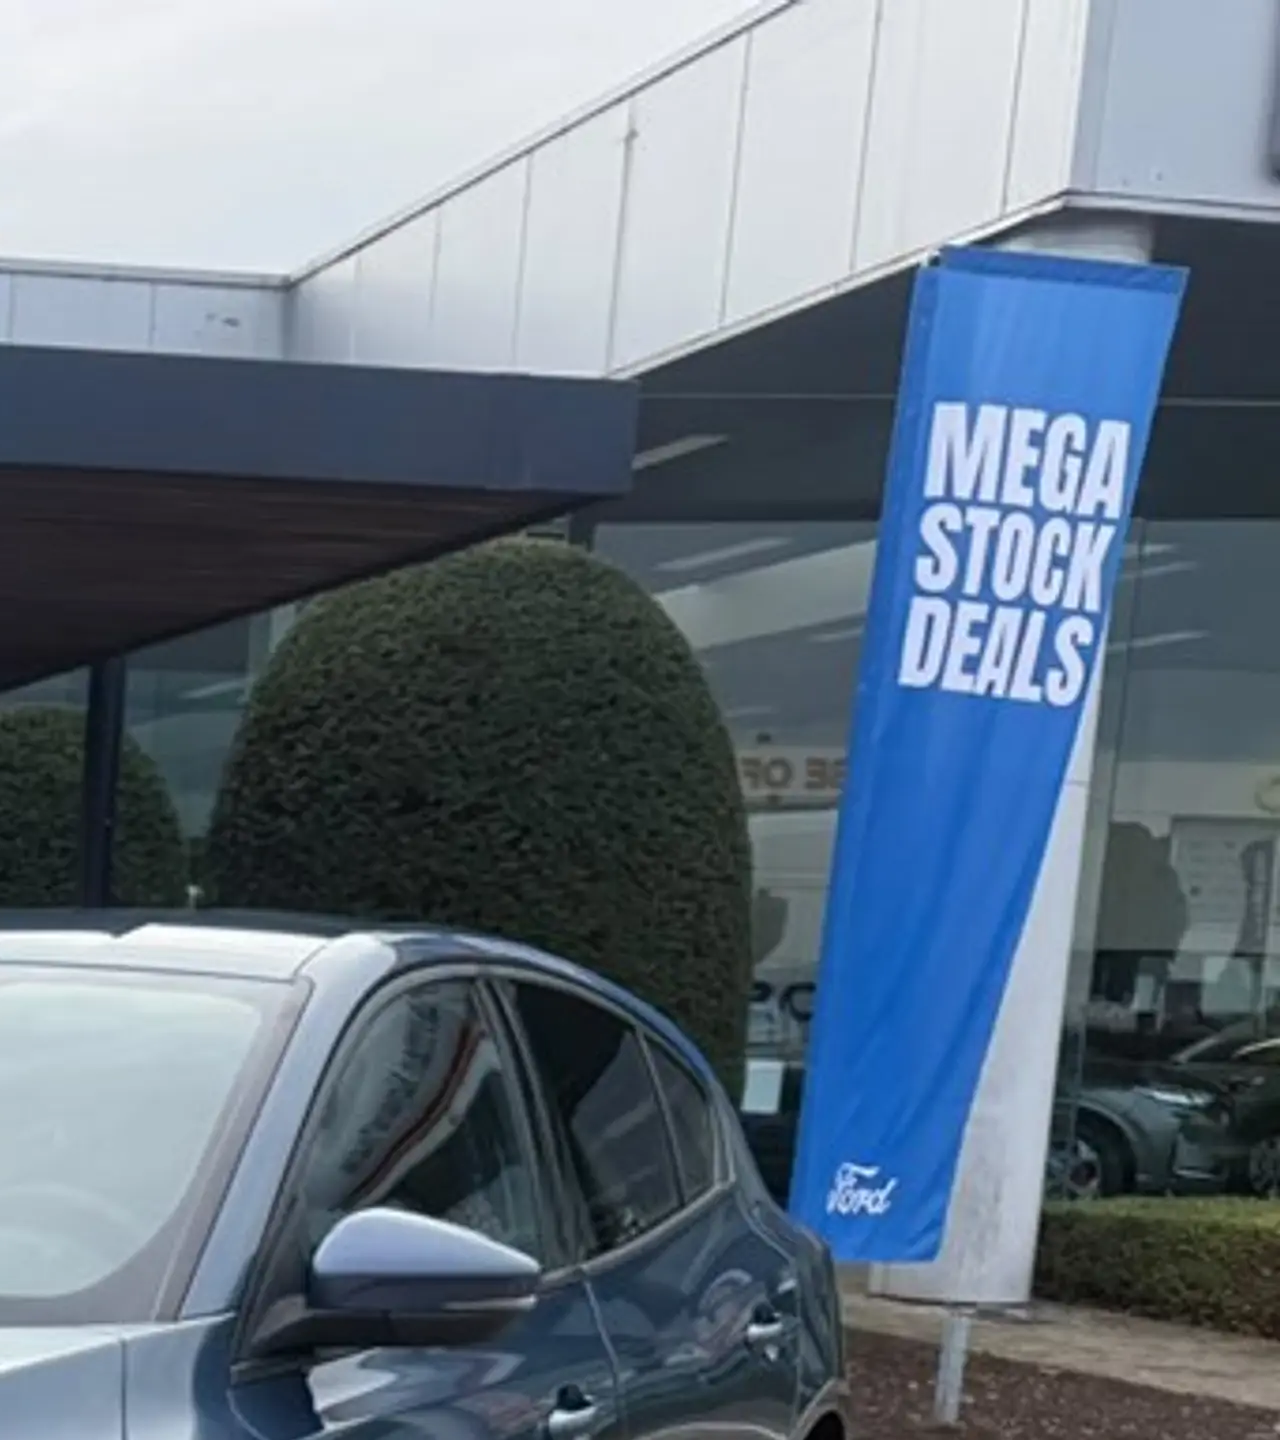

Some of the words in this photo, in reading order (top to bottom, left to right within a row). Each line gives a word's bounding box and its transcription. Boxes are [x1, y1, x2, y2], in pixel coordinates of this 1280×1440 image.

[923, 401, 1132, 520] MEGA
[915, 502, 1117, 614] STOCK
[896, 595, 1095, 709] DEALS
[825, 1161, 900, 1216] Ford
